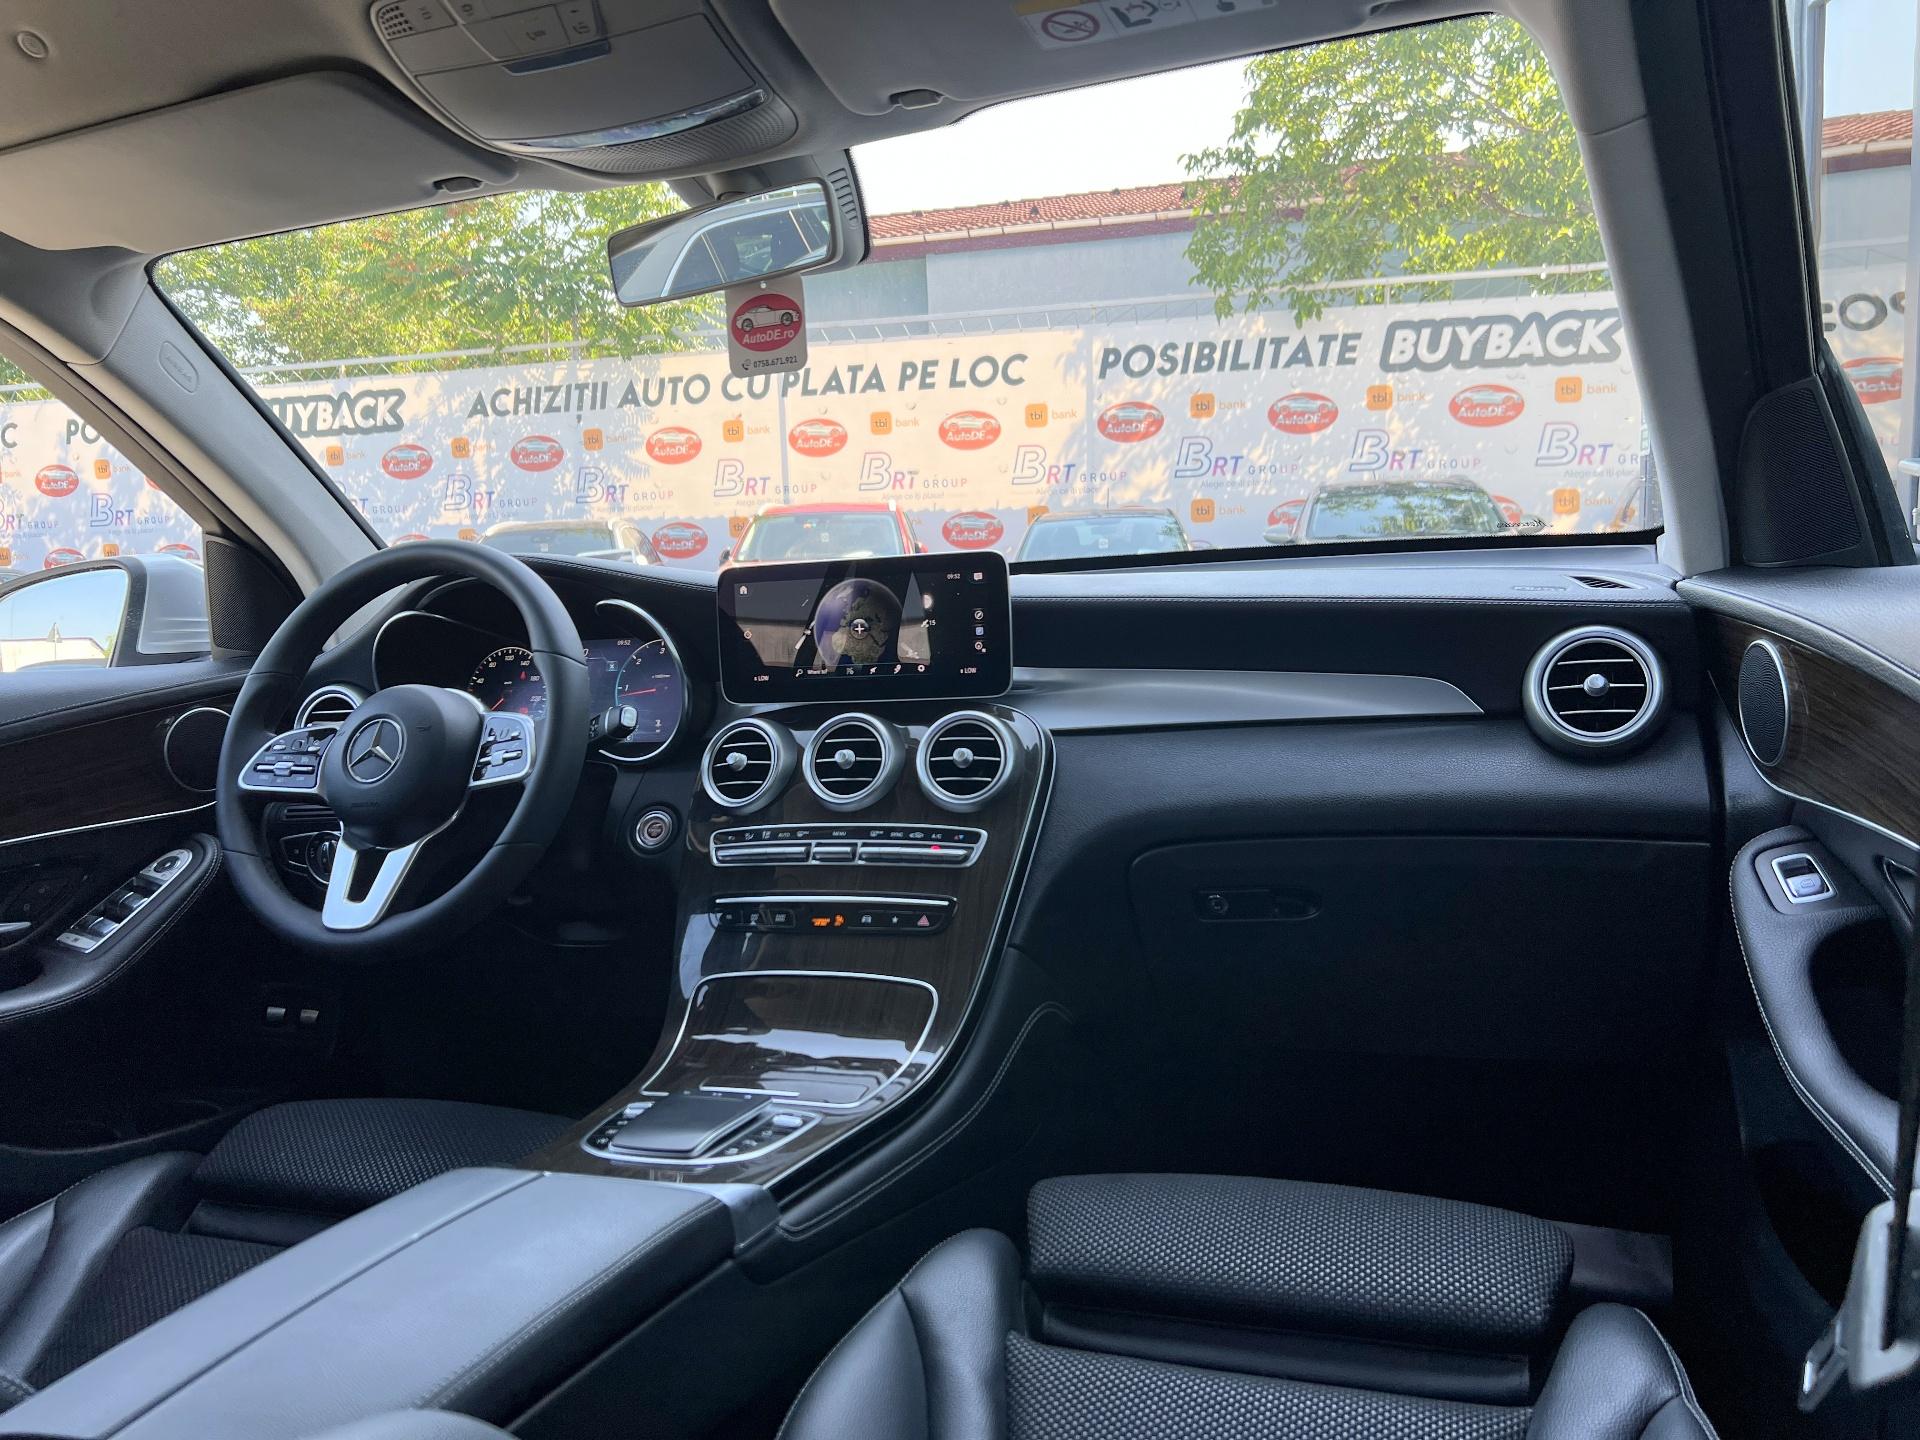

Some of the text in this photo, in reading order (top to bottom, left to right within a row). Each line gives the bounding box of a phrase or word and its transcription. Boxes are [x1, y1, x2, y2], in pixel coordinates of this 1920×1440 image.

[742, 329, 795, 344] AutoDE.ro
[1098, 314, 1626, 380] POSIBILITATE BUYBACK
[617, 373, 711, 410] AUTO
[721, 373, 771, 401] CU
[781, 363, 887, 398] PLATA
[897, 359, 940, 392] PE
[949, 353, 1030, 389] LOC
[271, 394, 402, 432] UYBACK
